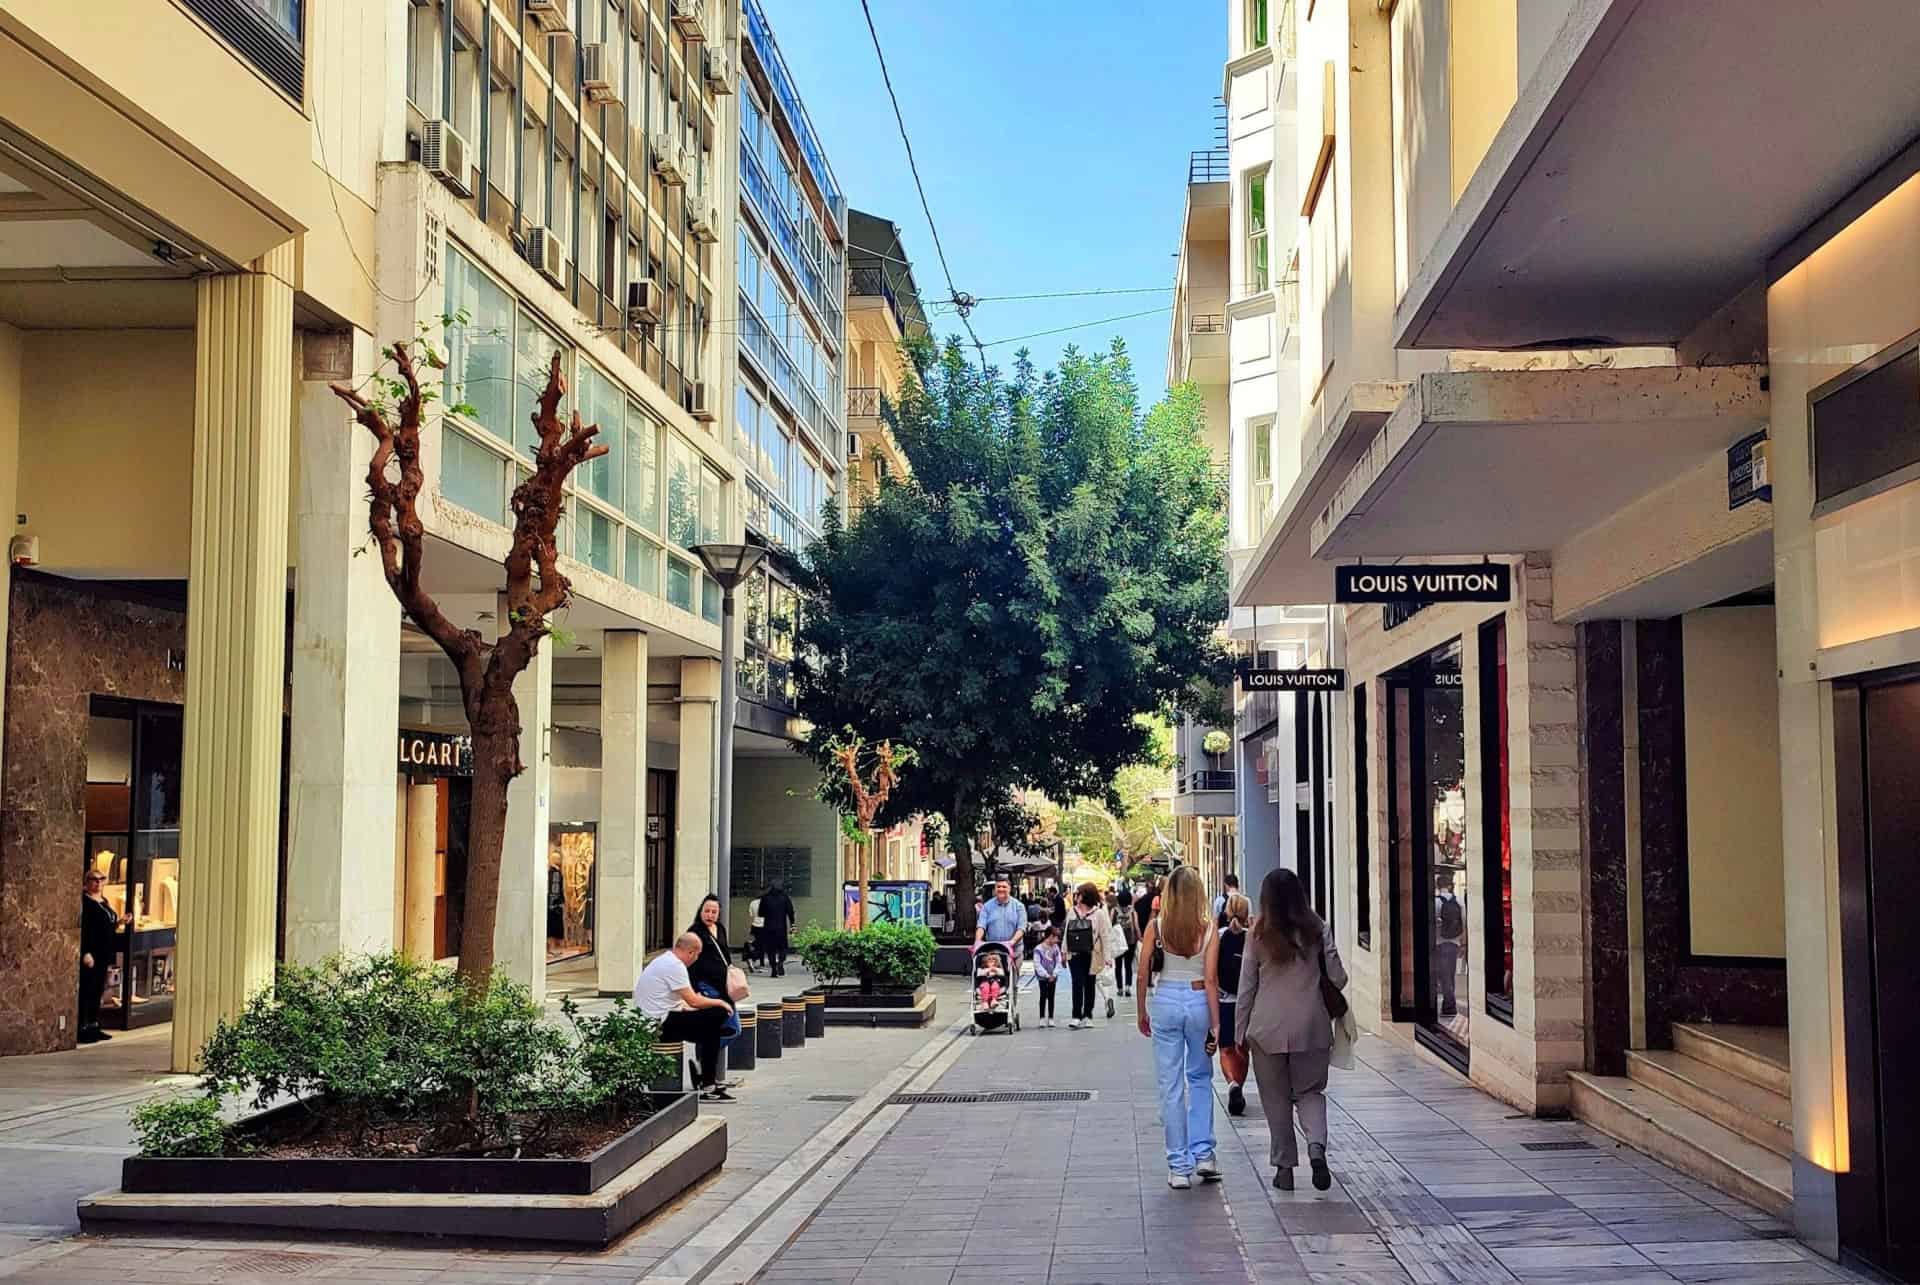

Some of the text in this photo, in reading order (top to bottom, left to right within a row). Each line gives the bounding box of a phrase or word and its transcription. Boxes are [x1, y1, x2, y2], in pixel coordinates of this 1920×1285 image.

[1350, 574, 1498, 593] LOUIS VUITTON
[1249, 674, 1337, 686] LOUIS VUITTON
[400, 737, 460, 767] LGARI
